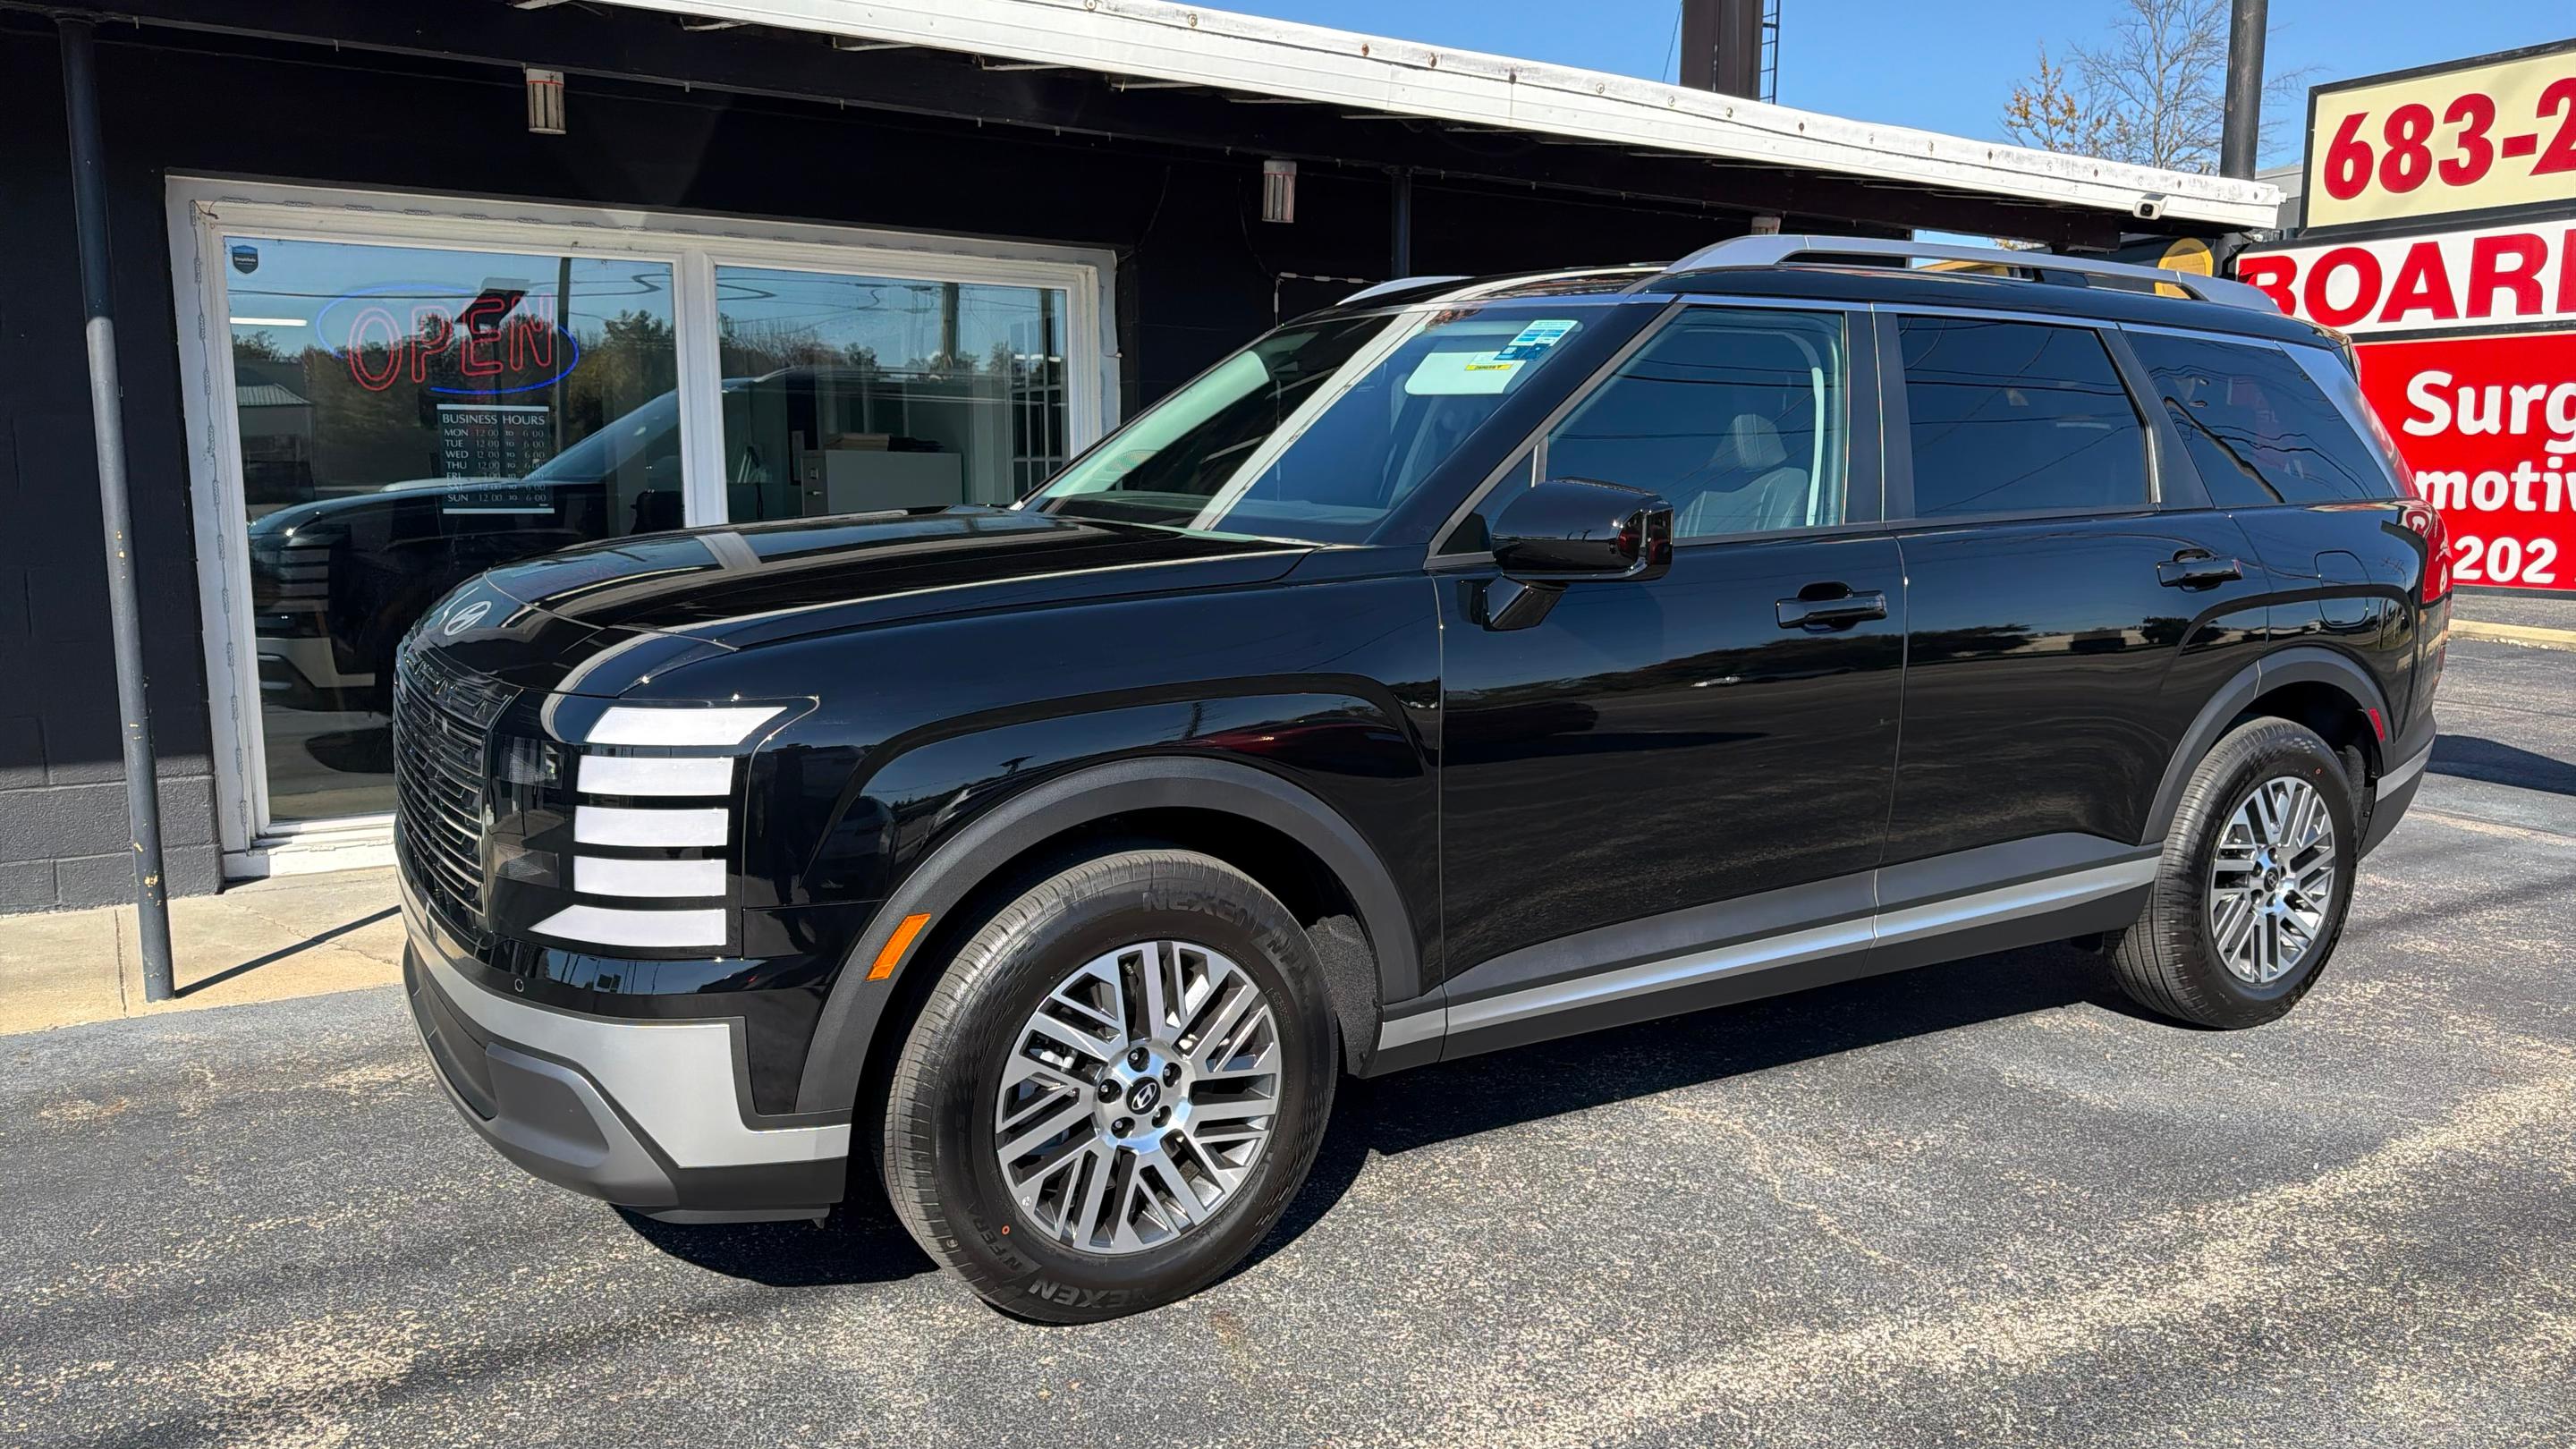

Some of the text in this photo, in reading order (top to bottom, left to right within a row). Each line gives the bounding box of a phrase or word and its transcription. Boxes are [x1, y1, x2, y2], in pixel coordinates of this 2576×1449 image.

[2324, 77, 2576, 200] 683-2
[2238, 228, 2576, 327] BOAR
[348, 292, 554, 391] OPEN
[442, 413, 546, 425] BUSINESS HOURS
[444, 428, 469, 436] MON
[445, 439, 463, 448] TUE
[445, 450, 469, 459] WED
[445, 461, 467, 470] THU
[446, 471, 462, 480] FRI
[2416, 456, 2576, 513] moti
[447, 494, 469, 502] SUN
[2453, 535, 2557, 584] 202
